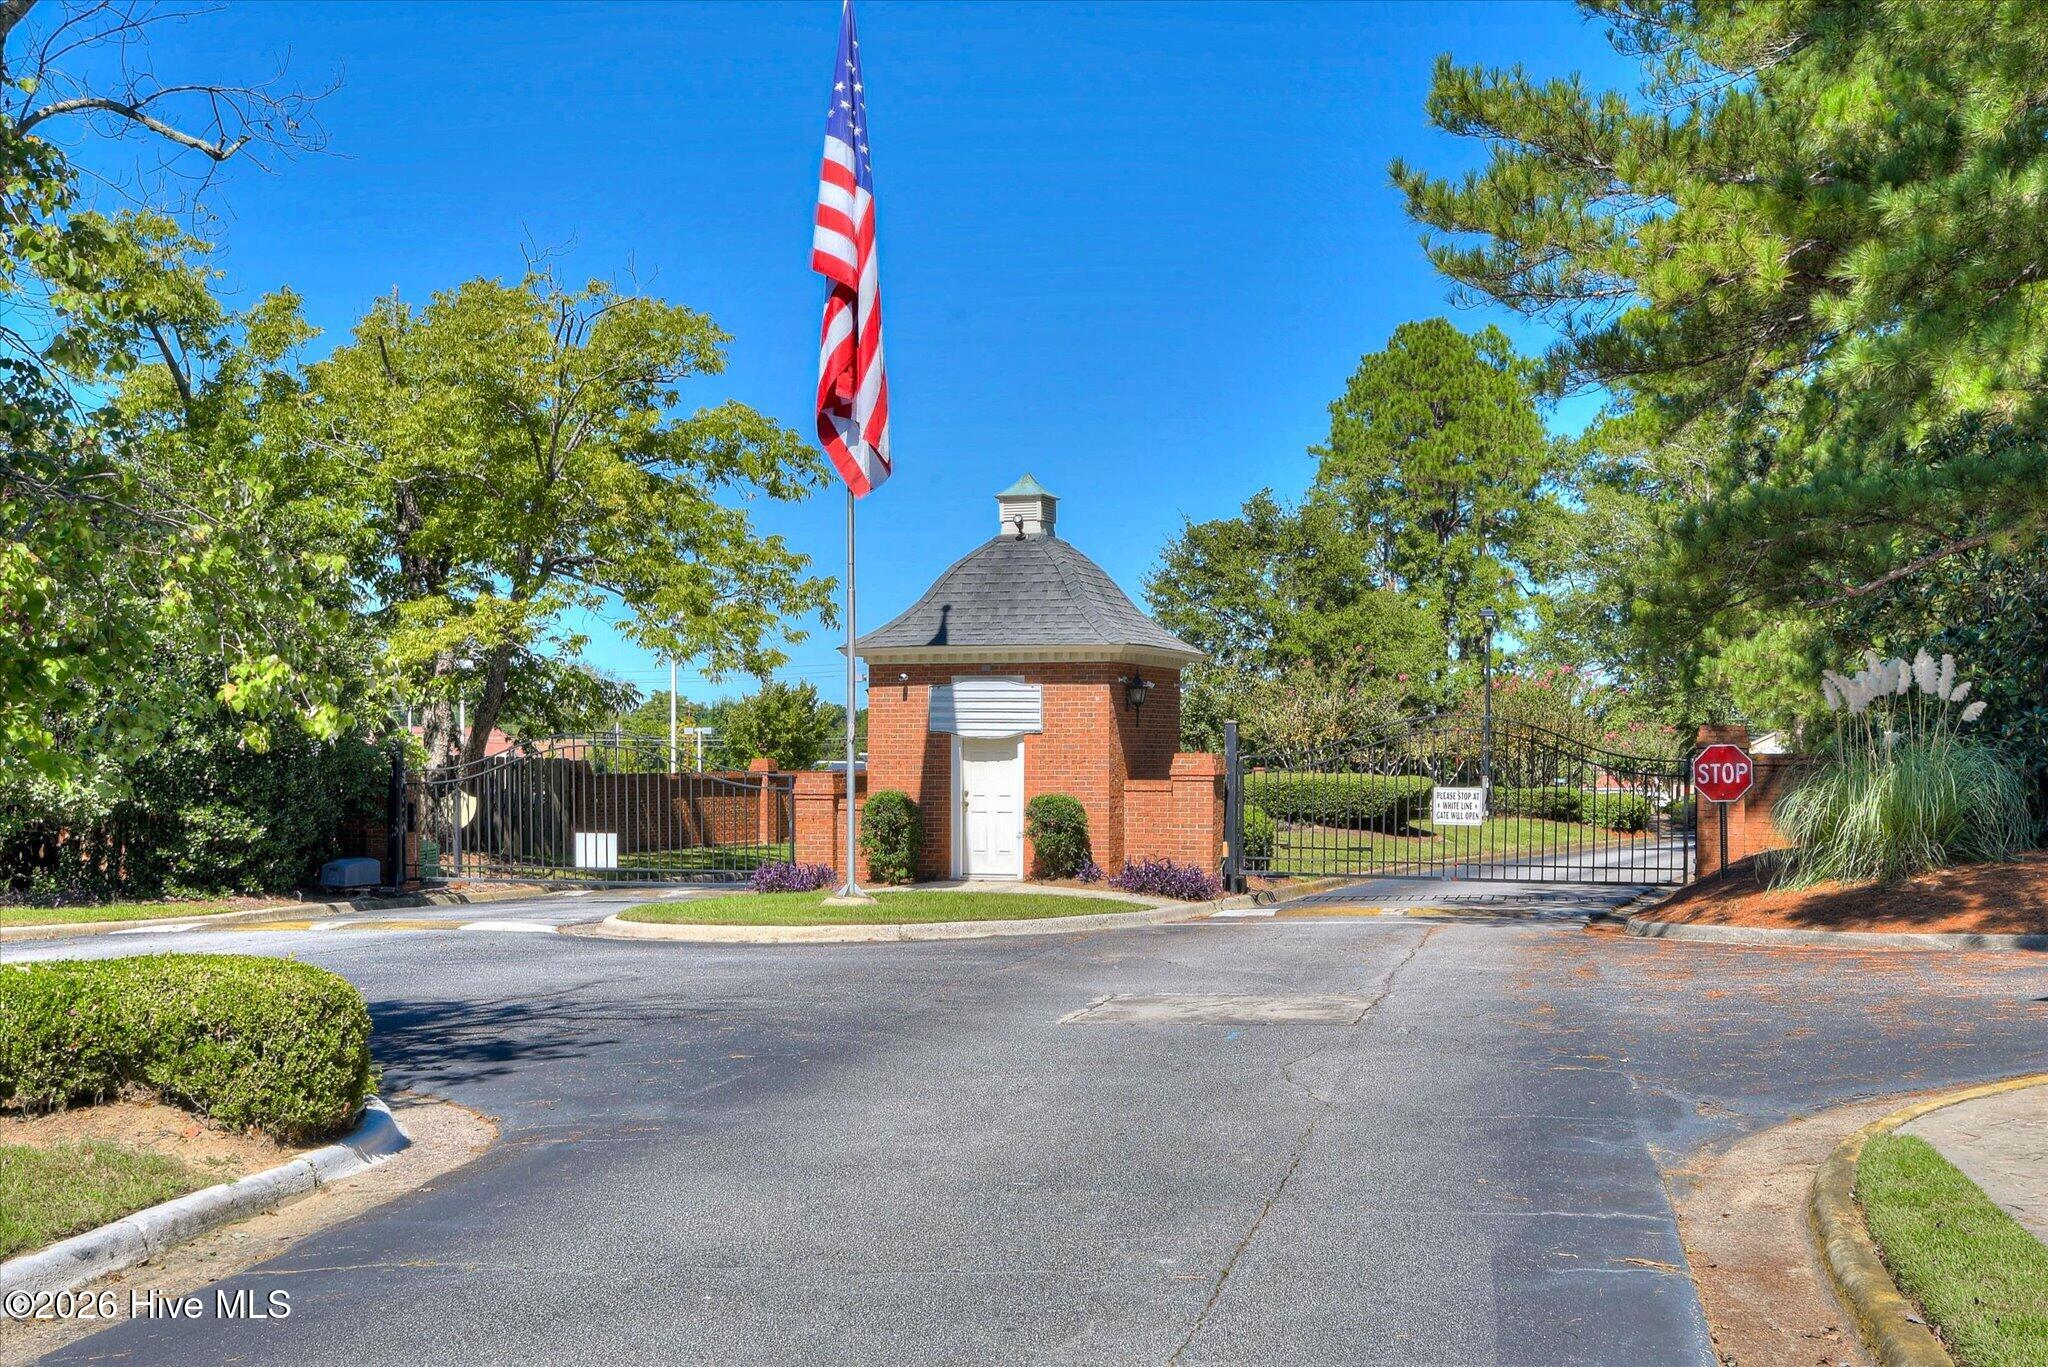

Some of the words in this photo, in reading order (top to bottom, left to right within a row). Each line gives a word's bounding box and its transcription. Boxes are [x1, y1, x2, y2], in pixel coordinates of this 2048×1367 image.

[1697, 762, 1748, 784] STOP
[1436, 791, 1456, 800] PLEASE
[1457, 791, 1472, 800] STOP
[1473, 792, 1480, 800] AT
[1442, 801, 1460, 810] WHITE
[1460, 802, 1473, 810] LINE
[1436, 811, 1450, 819] GATE
[1450, 811, 1464, 820] WILL
[1464, 811, 1480, 820] OPEN
